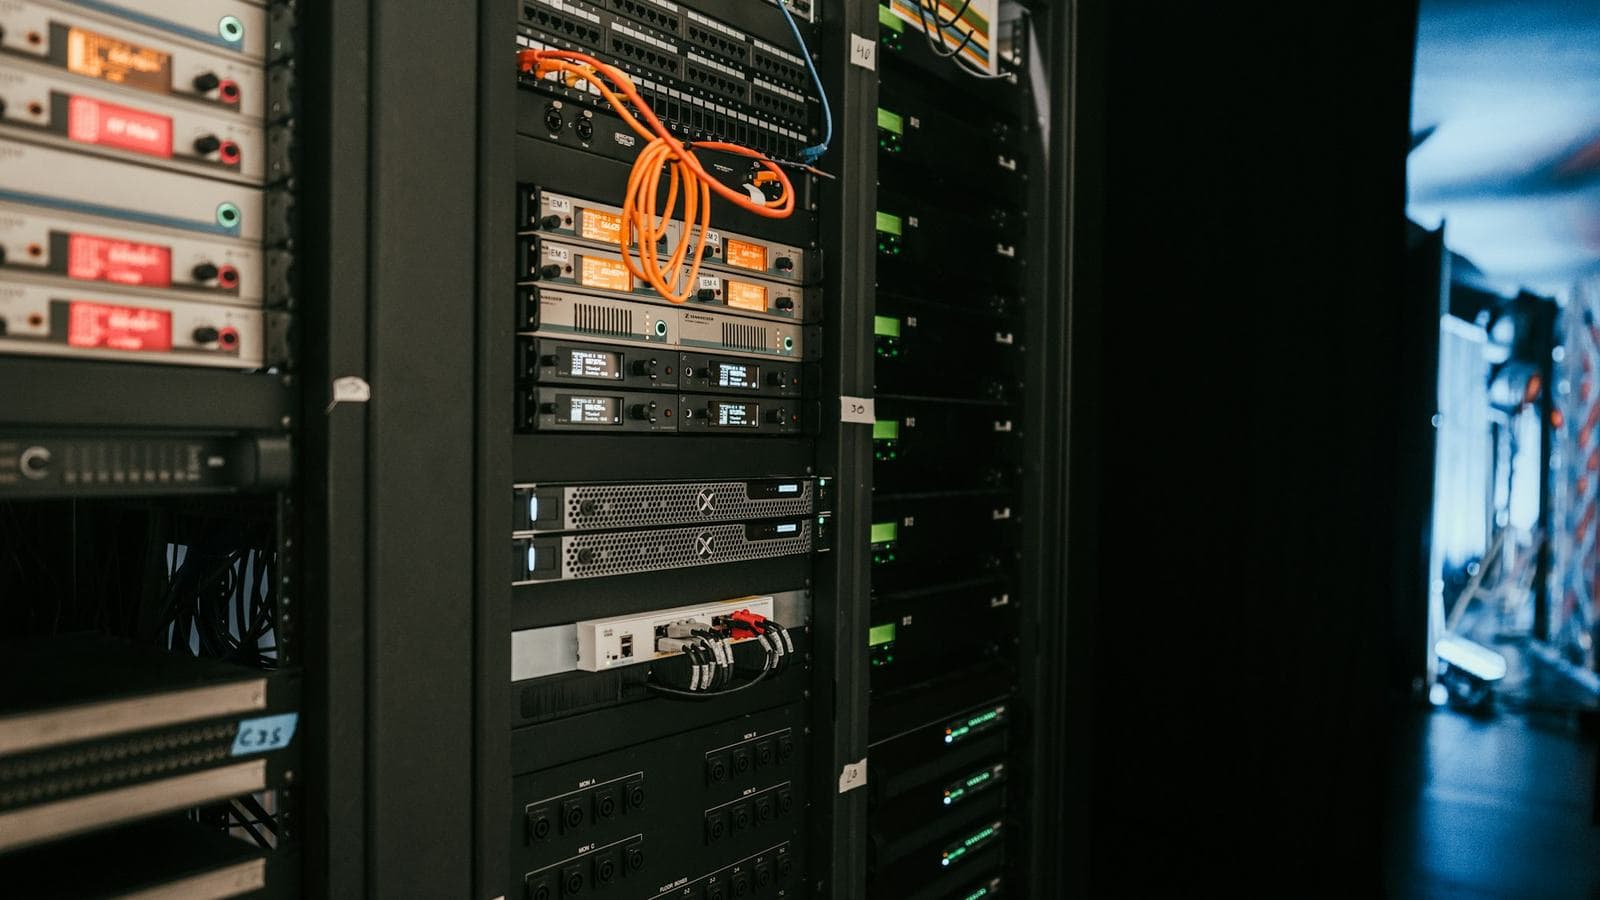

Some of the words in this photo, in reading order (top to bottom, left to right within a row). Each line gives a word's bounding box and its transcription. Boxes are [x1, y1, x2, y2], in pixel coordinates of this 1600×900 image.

[856, 43, 871, 60] 40
[850, 403, 865, 415] 30
[578, 780, 591, 788] MON
[578, 845, 590, 853] MON
